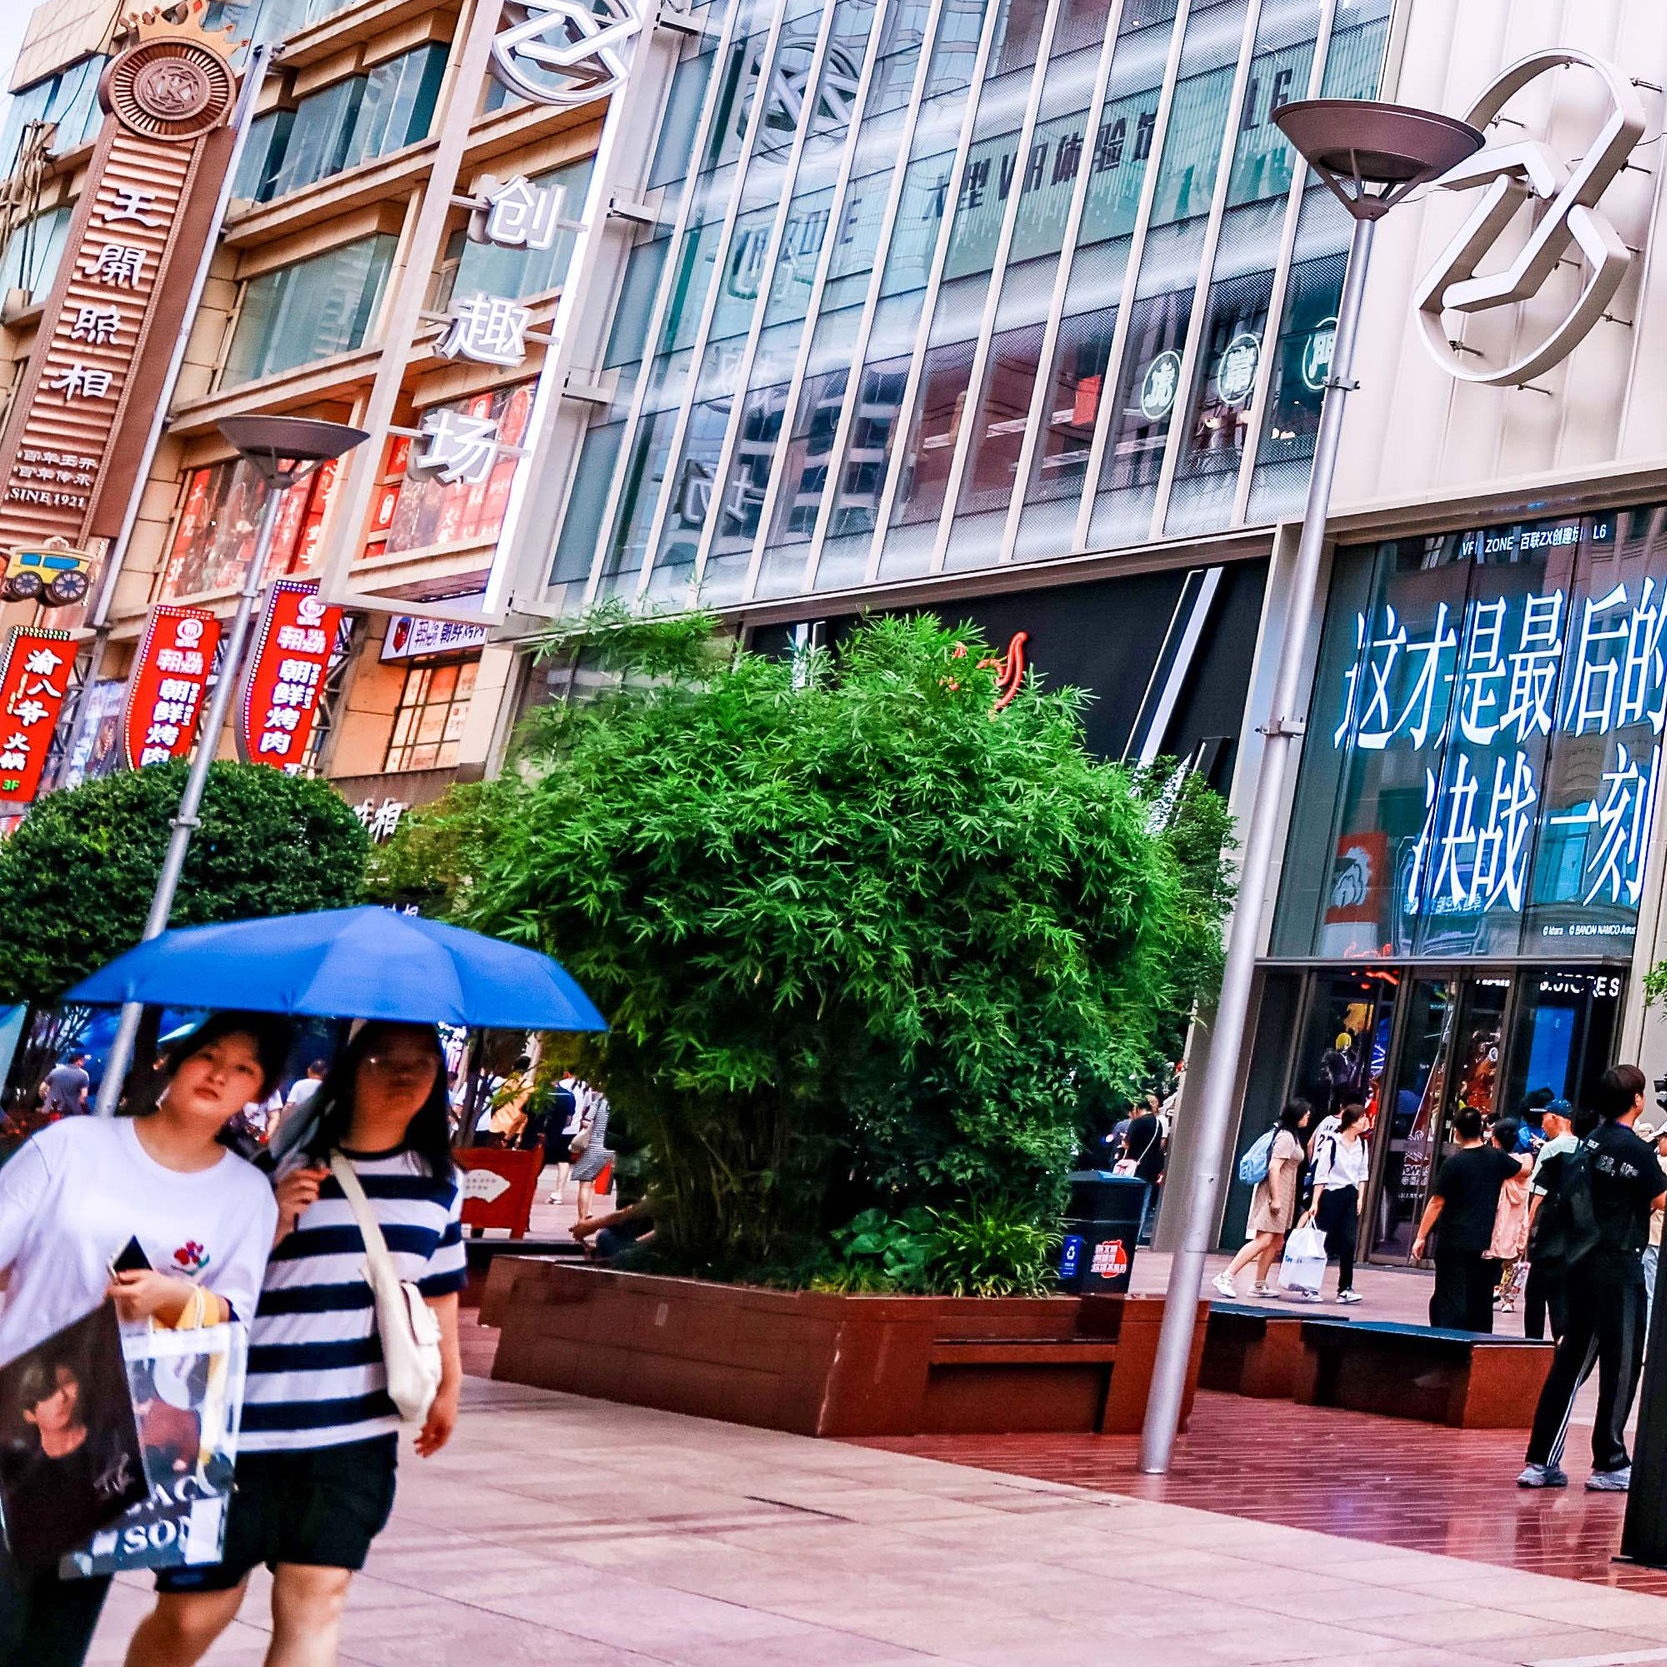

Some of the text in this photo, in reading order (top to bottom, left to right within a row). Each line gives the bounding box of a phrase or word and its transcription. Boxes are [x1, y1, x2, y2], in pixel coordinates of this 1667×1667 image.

[51, 187, 162, 401] 王開照相
[415, 174, 566, 486] 创趣场
[10, 487, 85, 509] SINE 1921
[1485, 537, 1515, 554] ZONE
[1593, 524, 1608, 540] L6
[13, 647, 64, 727] 渝八爷
[140, 677, 192, 767] 朝鲜烤肉
[260, 658, 311, 755] 朝鲜烤肉
[0, 732, 31, 772] 火锅
[2, 779, 20, 791] 3F
[1408, 742, 1662, 918] 决战一刻
